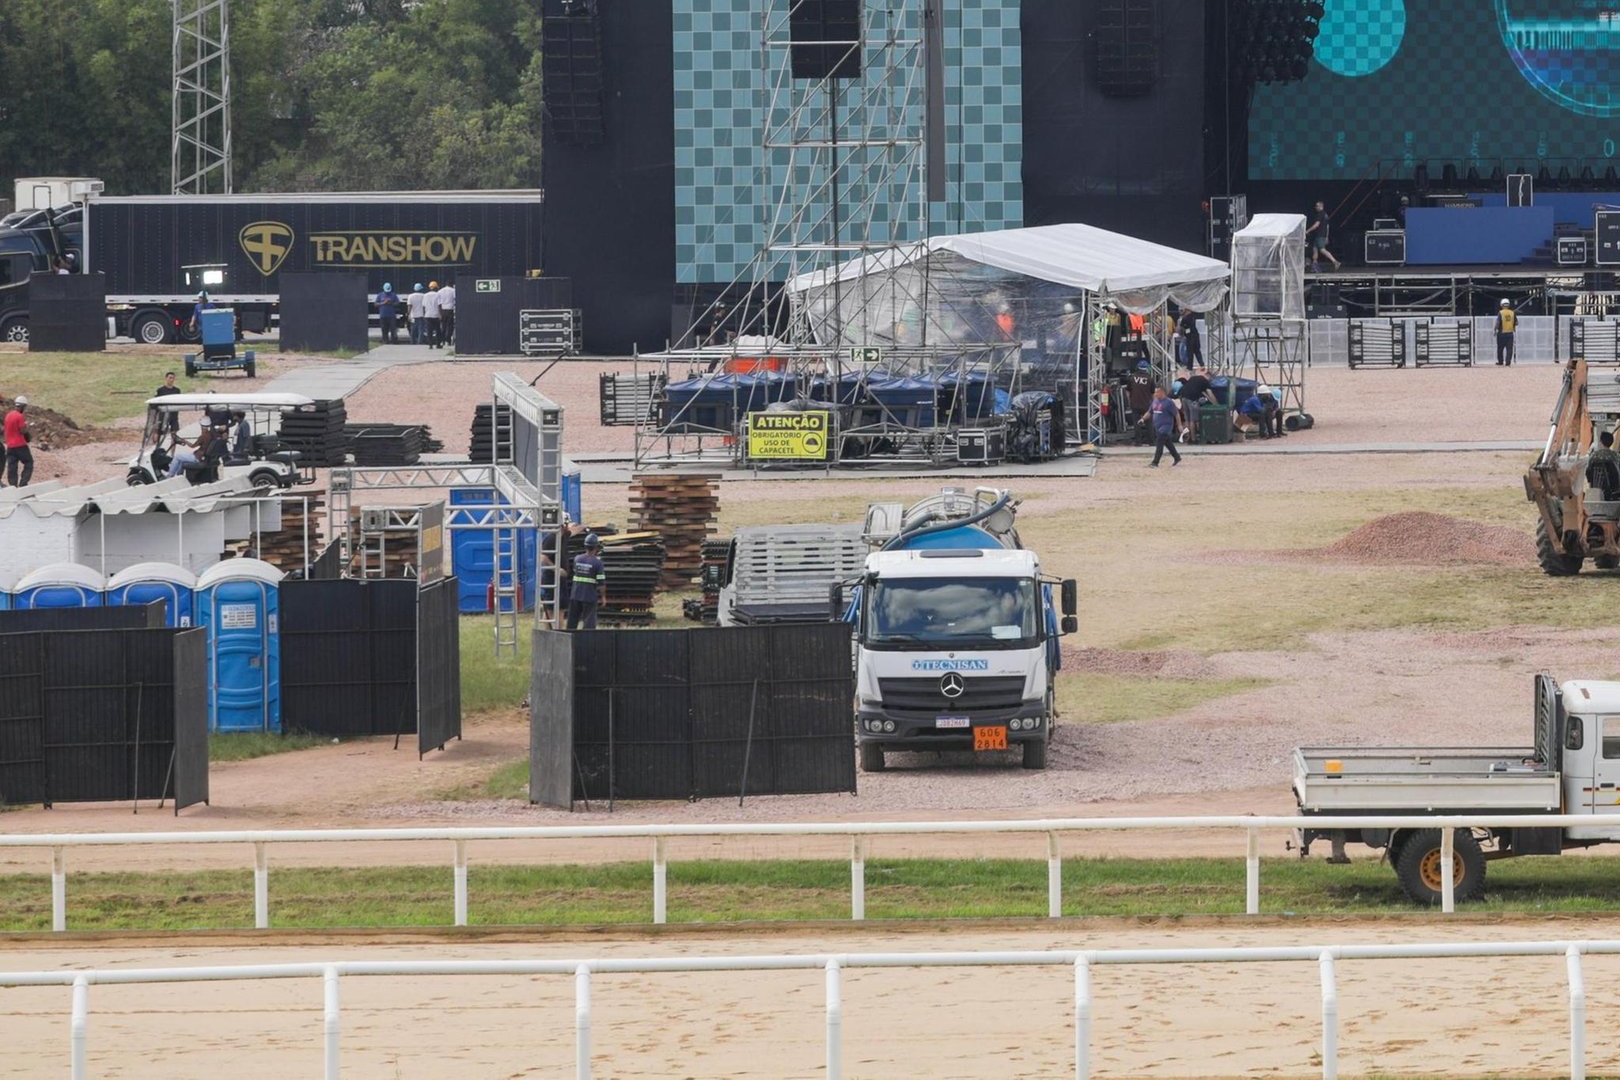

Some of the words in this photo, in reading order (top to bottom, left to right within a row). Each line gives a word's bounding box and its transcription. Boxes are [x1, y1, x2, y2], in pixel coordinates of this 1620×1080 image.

[309, 236, 477, 261] TRANSHOW
[757, 413, 820, 431] ATENÇÃO
[752, 430, 801, 439] OBRIGATÓRIO
[923, 660, 987, 670] TECNISAN
[980, 728, 1001, 738] 606
[977, 739, 1004, 749] 2814
